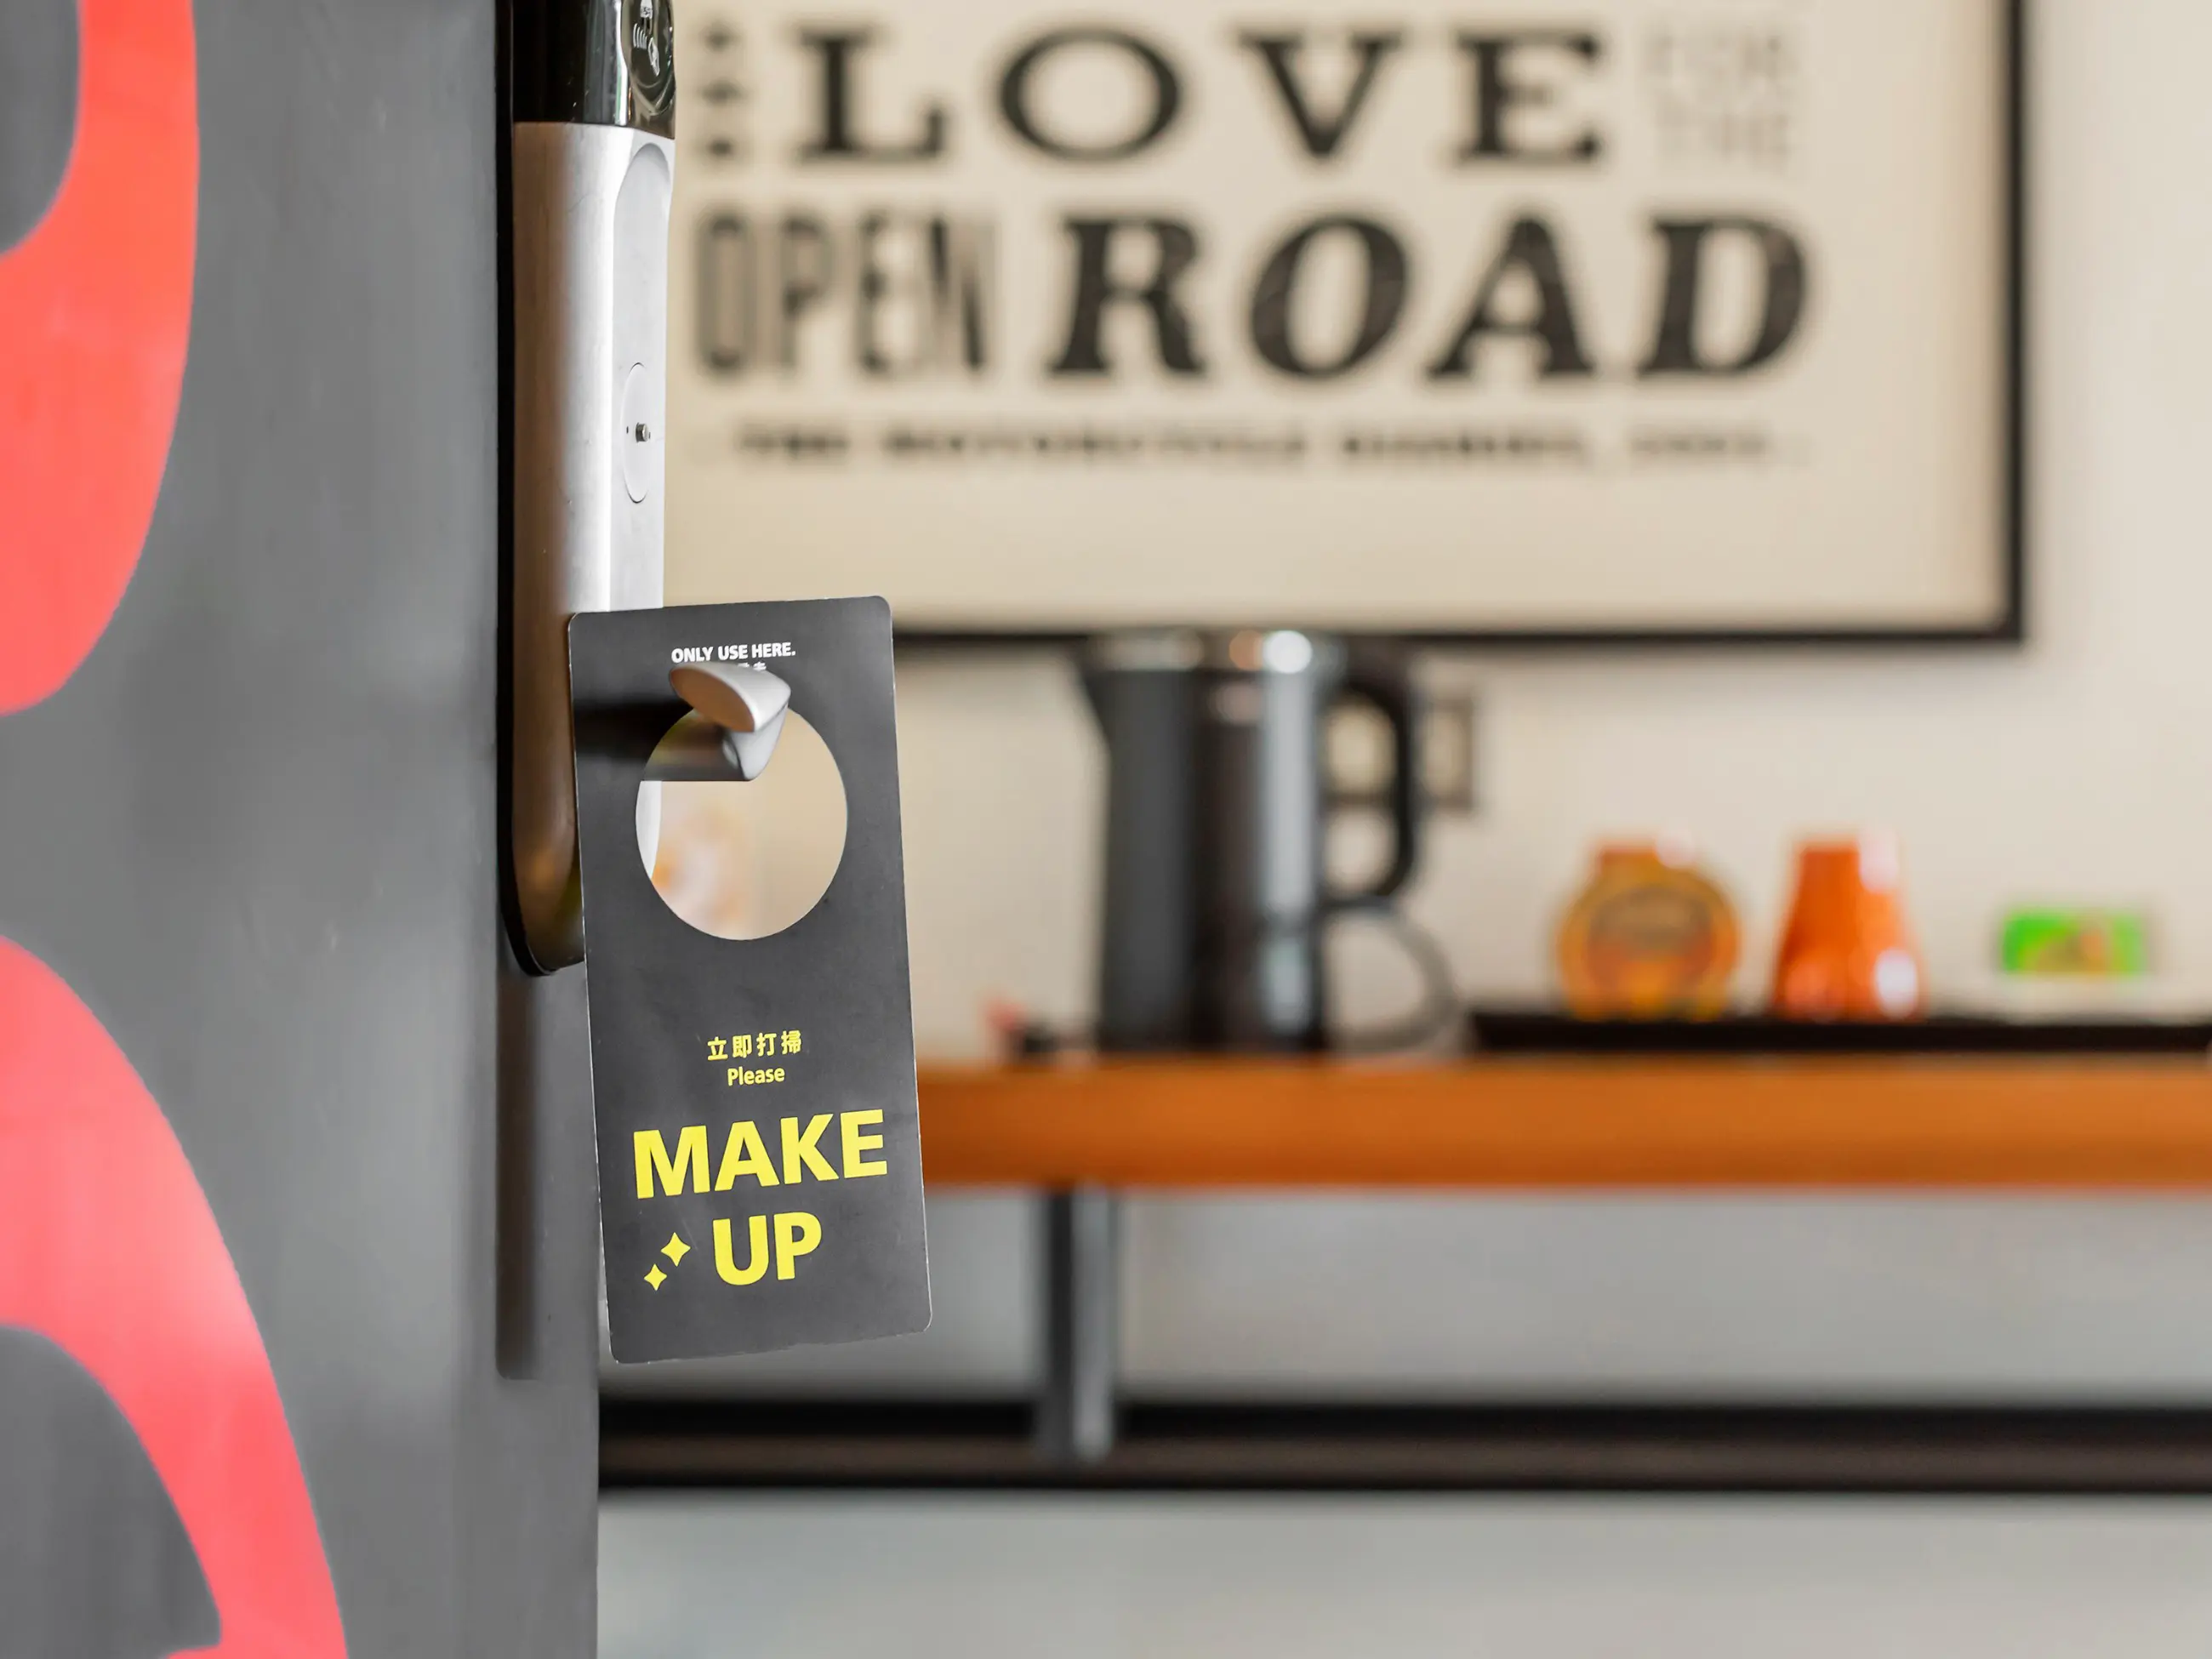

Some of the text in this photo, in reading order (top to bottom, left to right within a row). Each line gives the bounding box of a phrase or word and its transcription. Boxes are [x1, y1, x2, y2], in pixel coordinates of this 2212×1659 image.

[794, 23, 1606, 163] LOVE
[693, 206, 1812, 382] OPEN ROAD
[670, 641, 796, 664] ONLY USE HERE.
[706, 1029, 802, 1061] 立即打掃
[727, 1066, 785, 1086] Please
[633, 1109, 888, 1200] MAKE
[712, 1211, 823, 1286] UP
